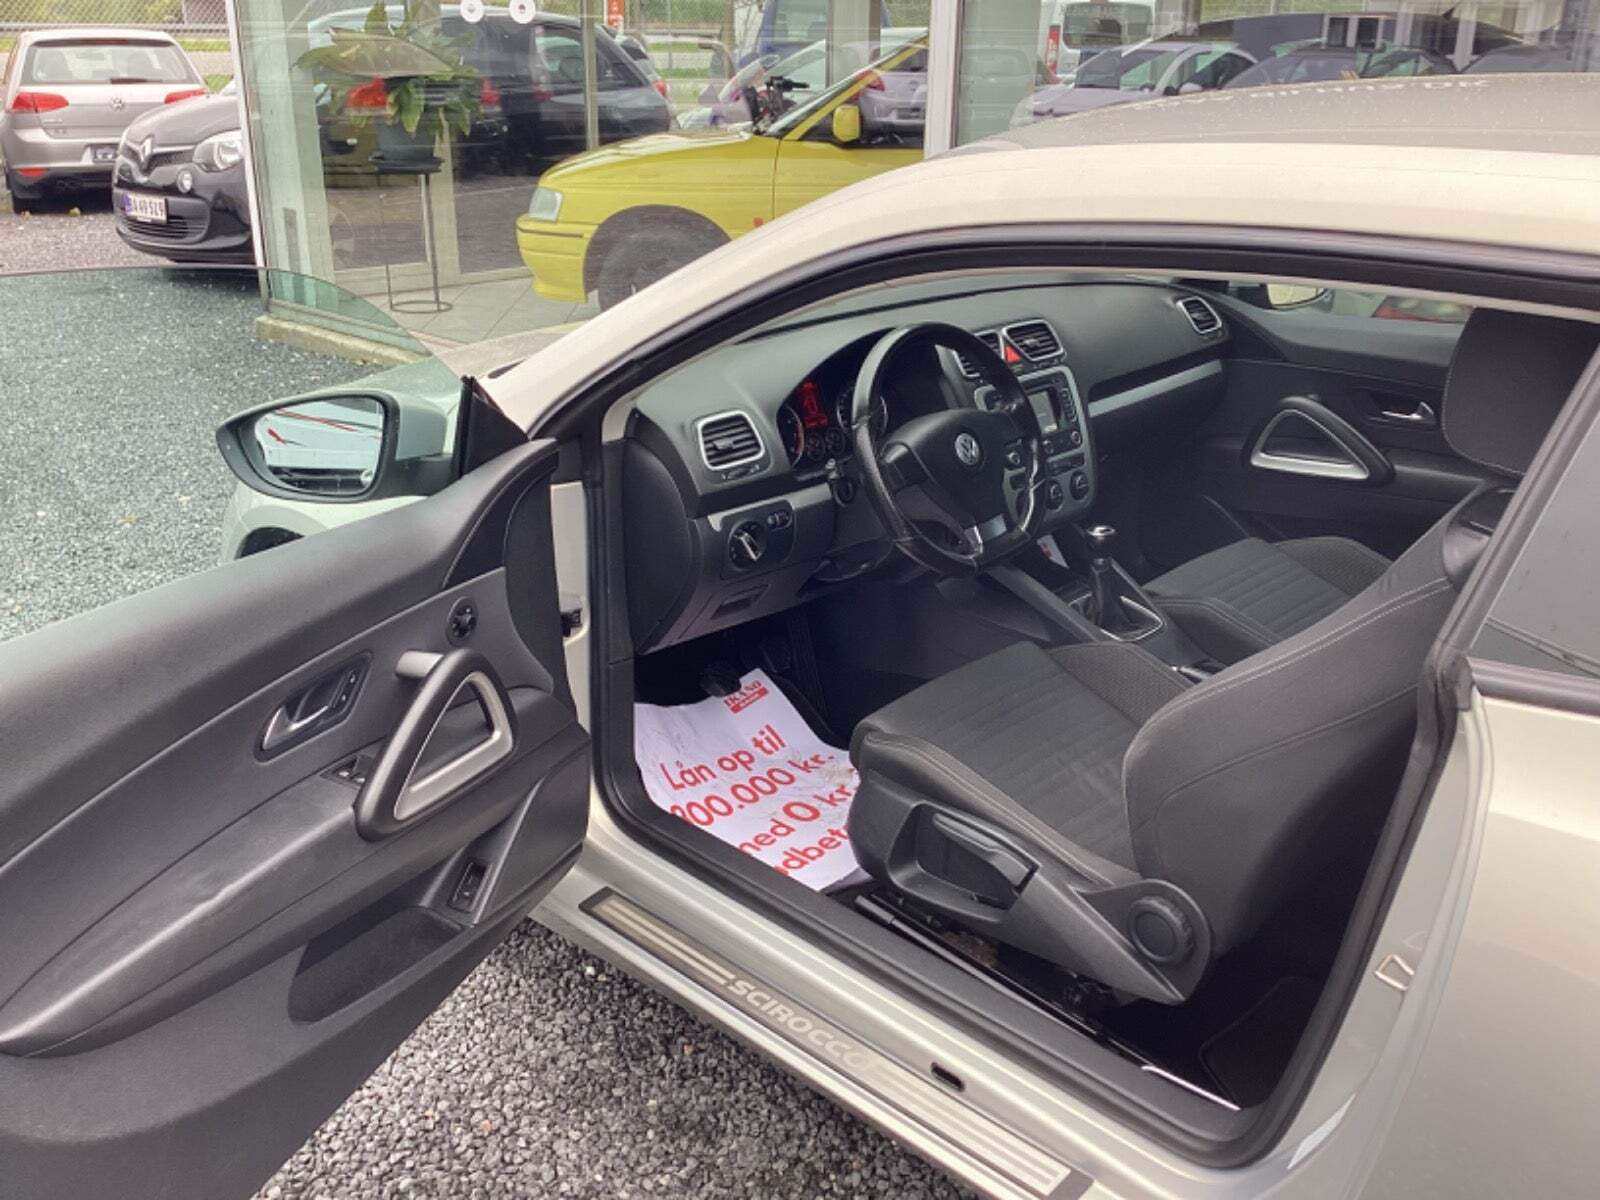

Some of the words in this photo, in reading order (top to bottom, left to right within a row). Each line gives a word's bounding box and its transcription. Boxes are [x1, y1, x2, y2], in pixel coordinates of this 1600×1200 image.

[659, 760, 717, 791] Lån
[717, 749, 755, 771] op
[752, 724, 786, 756] til
[787, 753, 835, 774] kr.
[728, 979, 868, 1069] SCIROCCO
